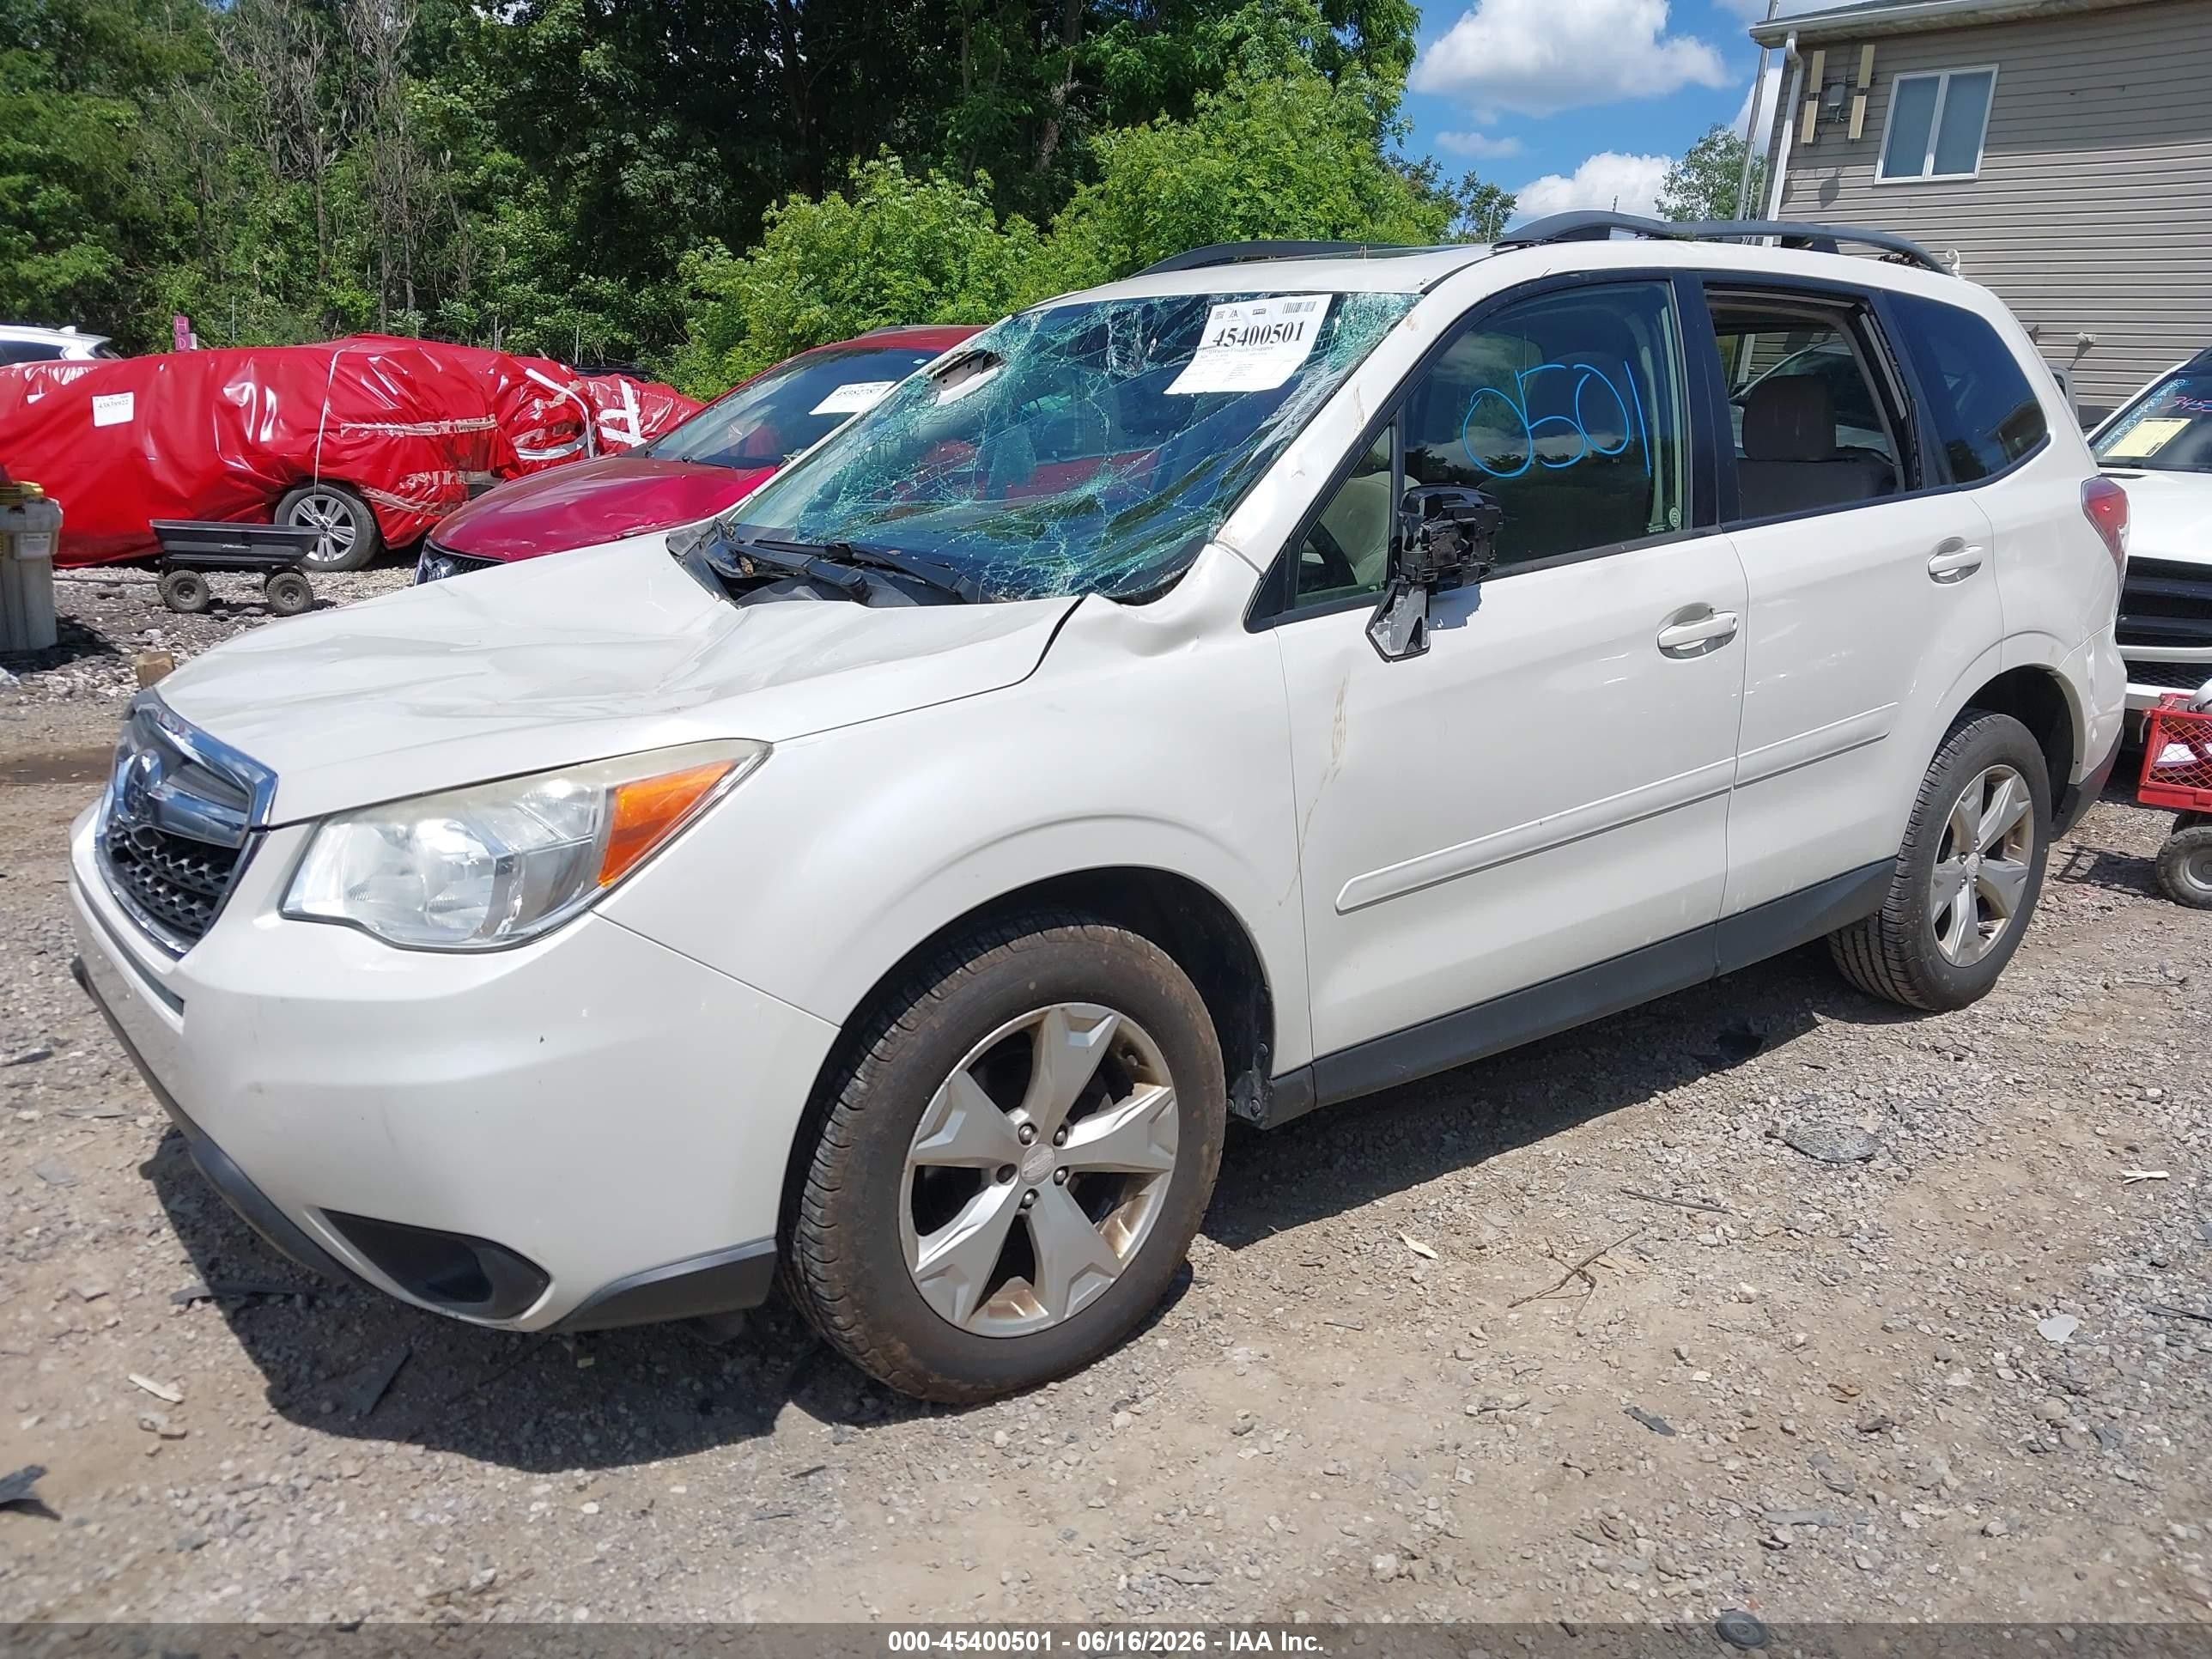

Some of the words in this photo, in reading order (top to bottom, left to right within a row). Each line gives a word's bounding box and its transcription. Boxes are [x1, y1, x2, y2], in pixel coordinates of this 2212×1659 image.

[176, 319, 187, 331] H
[1212, 320, 1305, 348] 45400501
[1462, 360, 1651, 478] 0501
